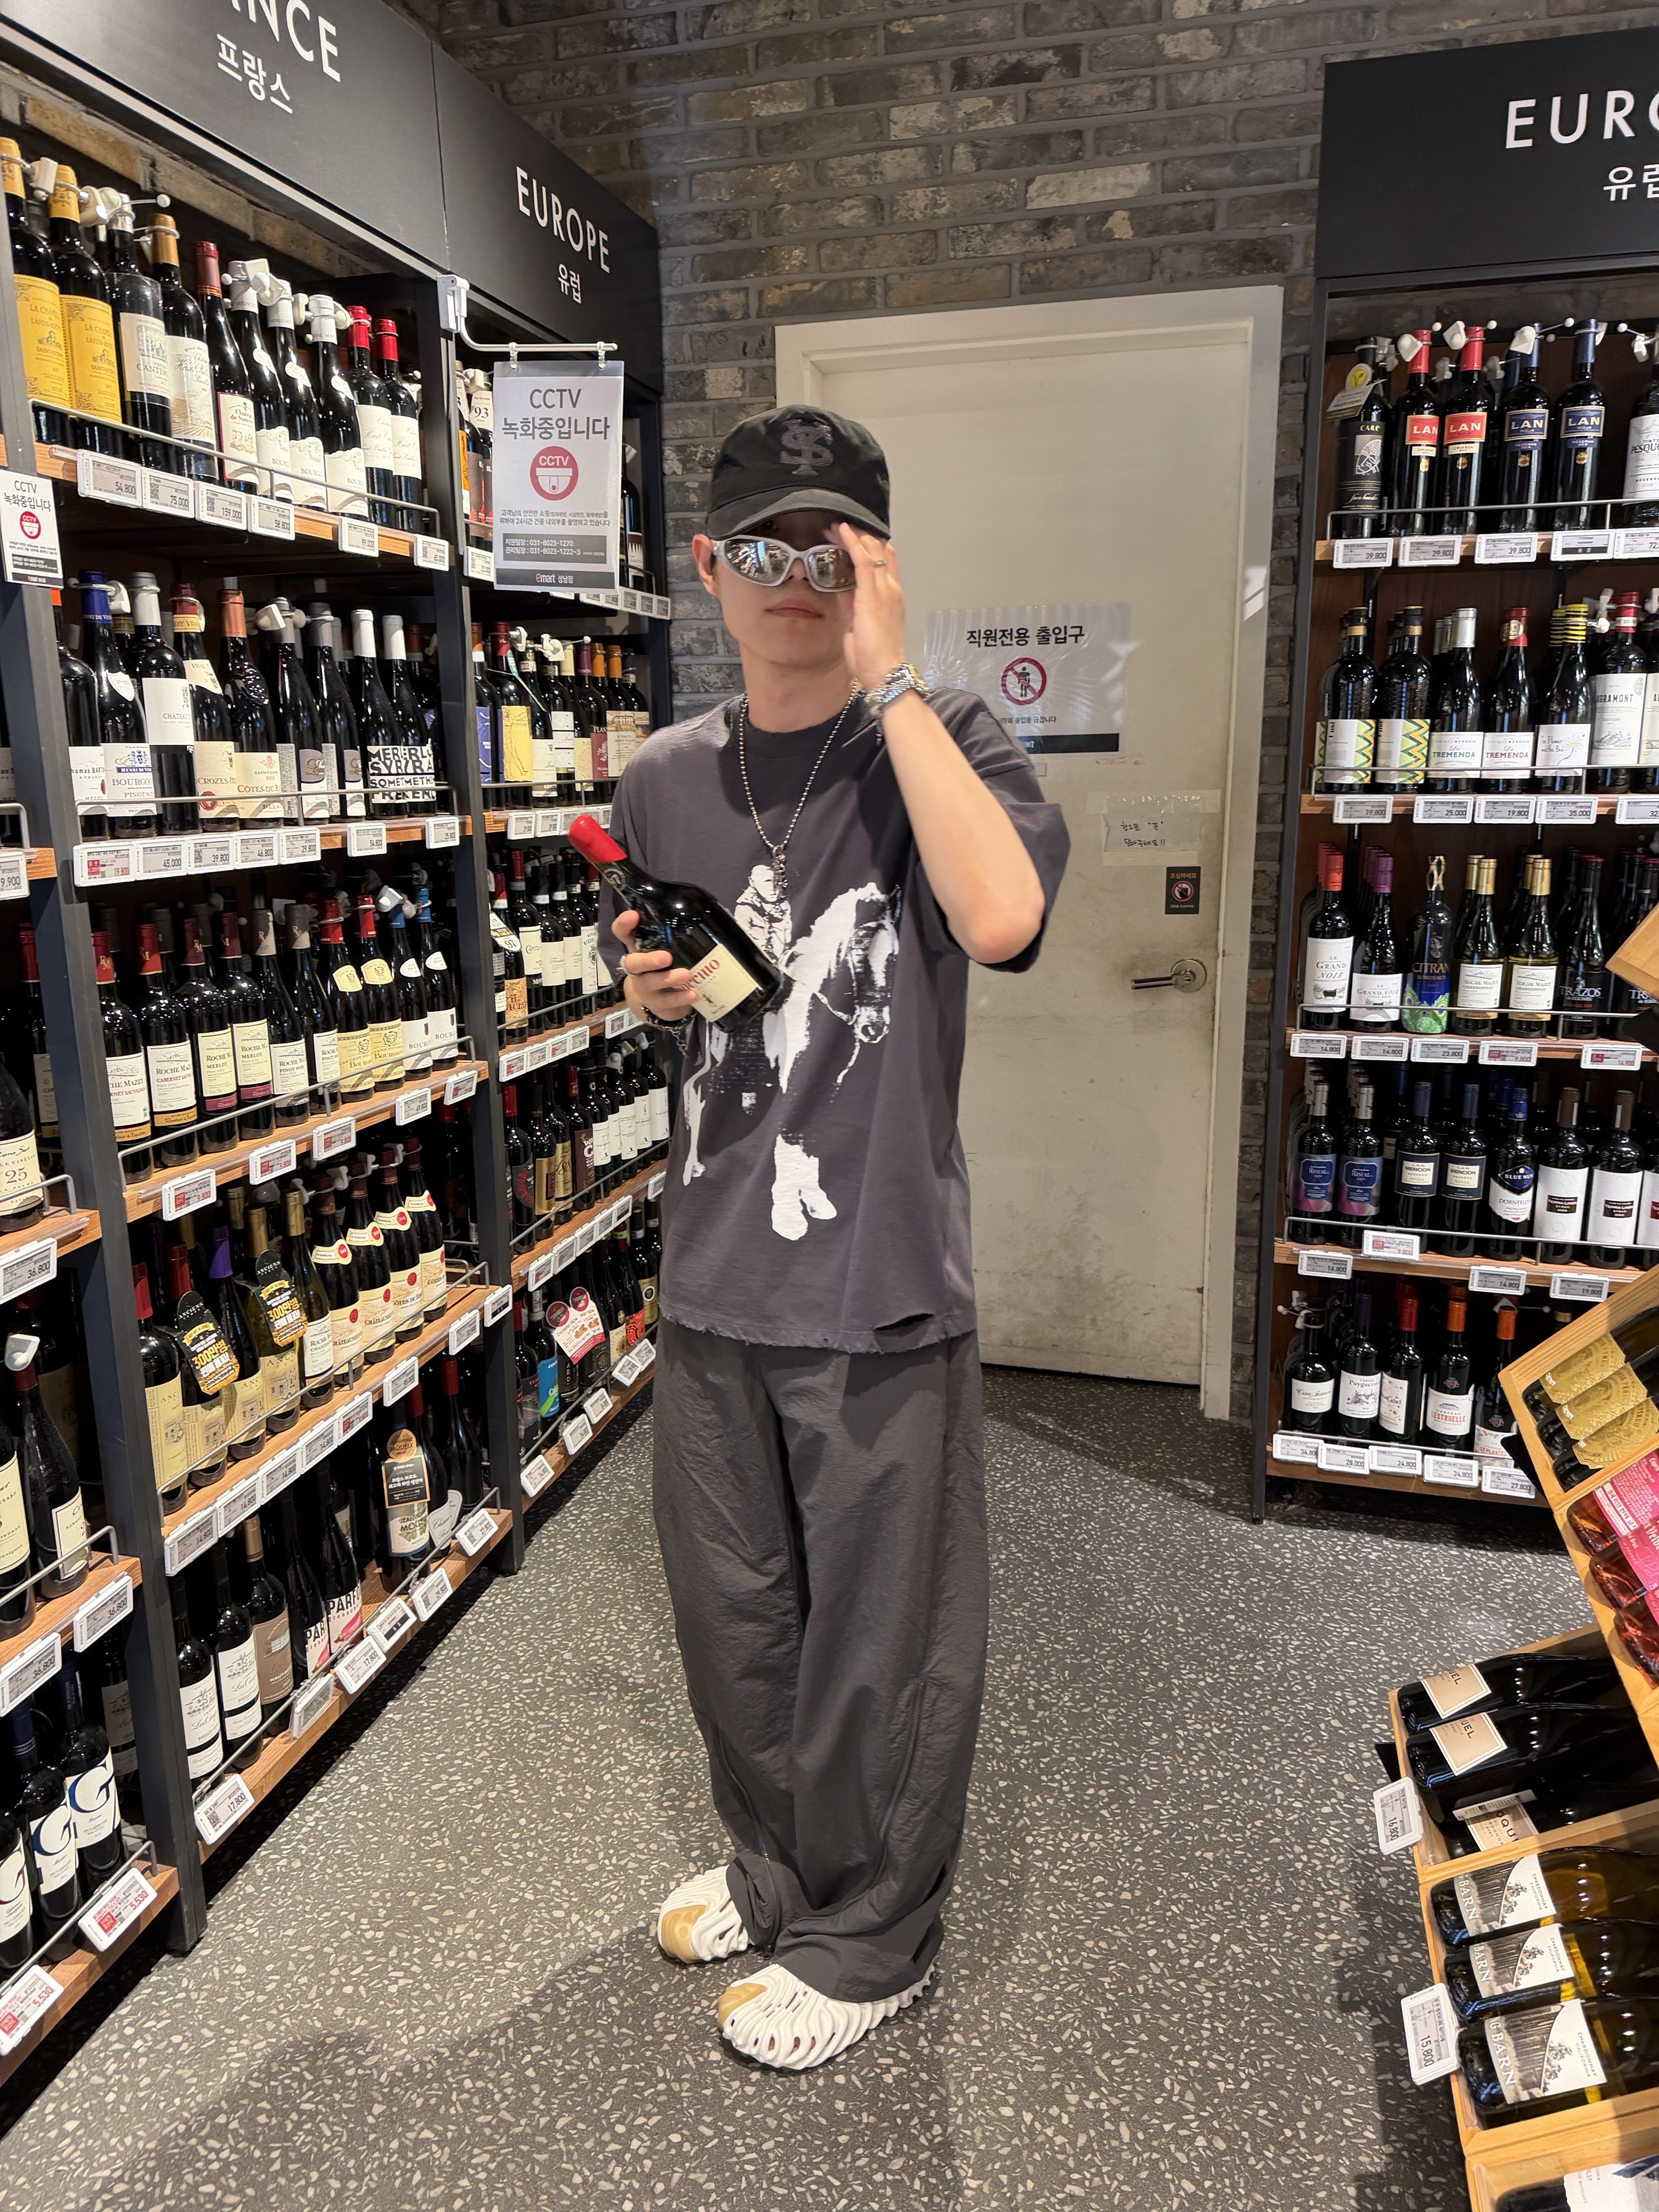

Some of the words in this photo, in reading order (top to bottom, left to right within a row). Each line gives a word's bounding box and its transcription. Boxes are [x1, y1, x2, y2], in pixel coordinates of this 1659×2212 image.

[217, 33, 292, 113] 프랑스
[1506, 90, 1659, 149] EUR
[516, 166, 610, 274] EUROPE
[558, 264, 582, 304] 유럽
[529, 388, 582, 408] CCTV
[475, 407, 489, 419] 93
[1568, 416, 1600, 427] LAN
[502, 416, 610, 440] 녹화중입니다
[1413, 425, 1438, 434] LAN
[1449, 422, 1481, 433] LAN
[1512, 419, 1543, 430] LAN
[539, 455, 569, 466] CCTV
[14, 480, 37, 494] CCTV
[4, 493, 51, 512] 녹화중입니다
[22, 515, 36, 523] CCTV
[536, 573, 555, 583] emart
[557, 575, 573, 584] 성남점
[967, 627, 1030, 648] 직원전용
[1035, 625, 1084, 645] 출입구
[1548, 736, 1562, 744] Flower
[504, 940, 517, 948] 97
[1560, 986, 1601, 997] TRAZOS
[124, 1078, 144, 1087] MAZET
[5, 1168, 28, 1184] 25
[257, 1260, 280, 1275] ANCIENS
[179, 1302, 204, 1319] ANCIENS
[267, 1297, 301, 1321] 300만병
[191, 1339, 230, 1370] 300만병
[1431, 1411, 1466, 1423] LESTRUELLE
[1458, 1880, 1478, 1920] BARN
[1529, 1881, 1543, 1911] CALIFORNIA
[1532, 1873, 1548, 1910] CHARDONNAY
[1547, 1945, 1560, 1973] CALIFORNIA
[1550, 1937, 1566, 1972] CHARDONNAY
[1491, 2031, 1517, 2086] BARN
[1575, 2042, 1591, 2078] CALIFORNIA
[1577, 2032, 1598, 2078] CHARDONNAY
